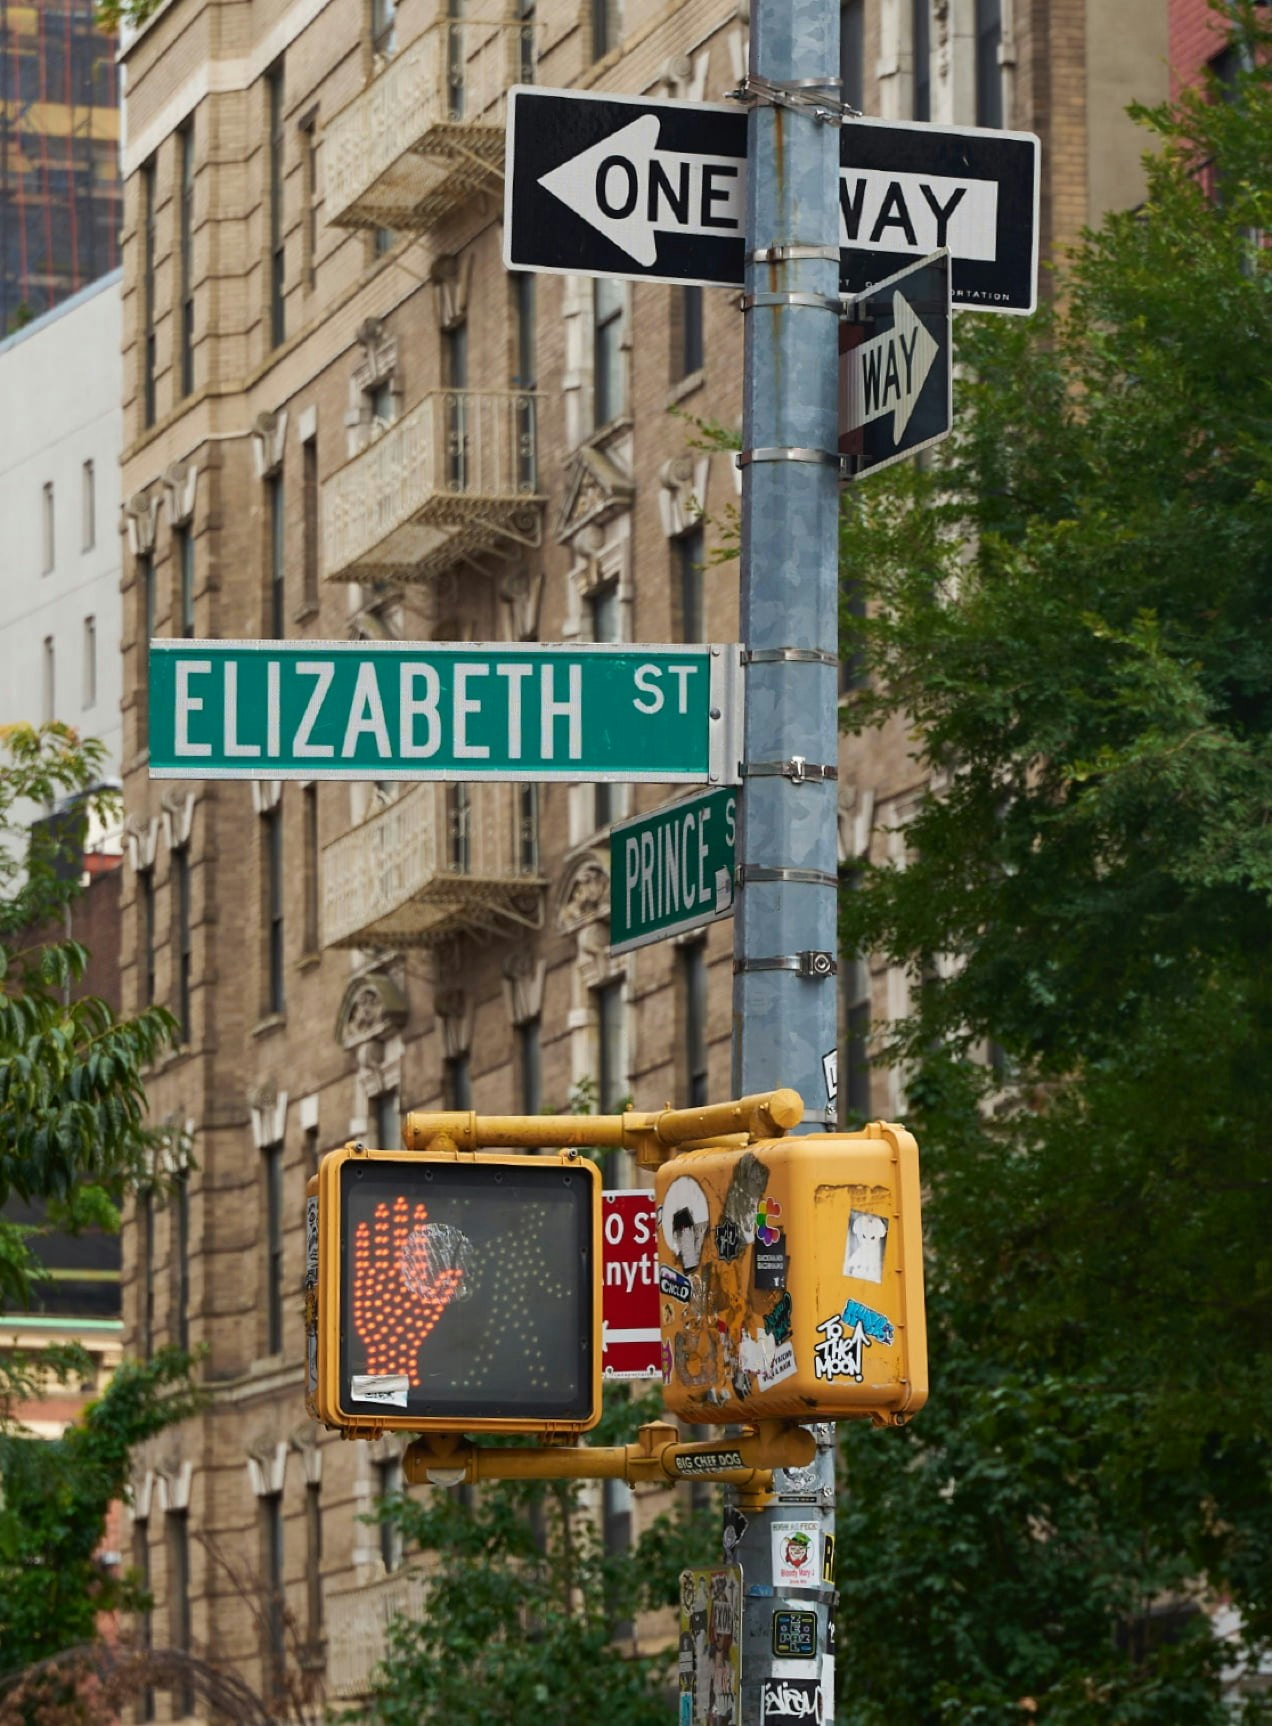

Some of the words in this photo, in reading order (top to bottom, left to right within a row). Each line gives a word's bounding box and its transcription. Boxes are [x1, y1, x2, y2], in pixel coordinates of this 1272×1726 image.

[595, 154, 738, 229] ONE
[862, 326, 918, 416] WAY
[174, 660, 582, 760] ELIZABETH
[632, 663, 698, 715] ST
[625, 806, 712, 929] PRINCE
[725, 797, 736, 847] S
[604, 1212, 624, 1245] O
[602, 1252, 660, 1293] nyti
[816, 1314, 843, 1340] TO
[675, 1456, 693, 1469] BIG
[717, 1452, 742, 1466] DOG
